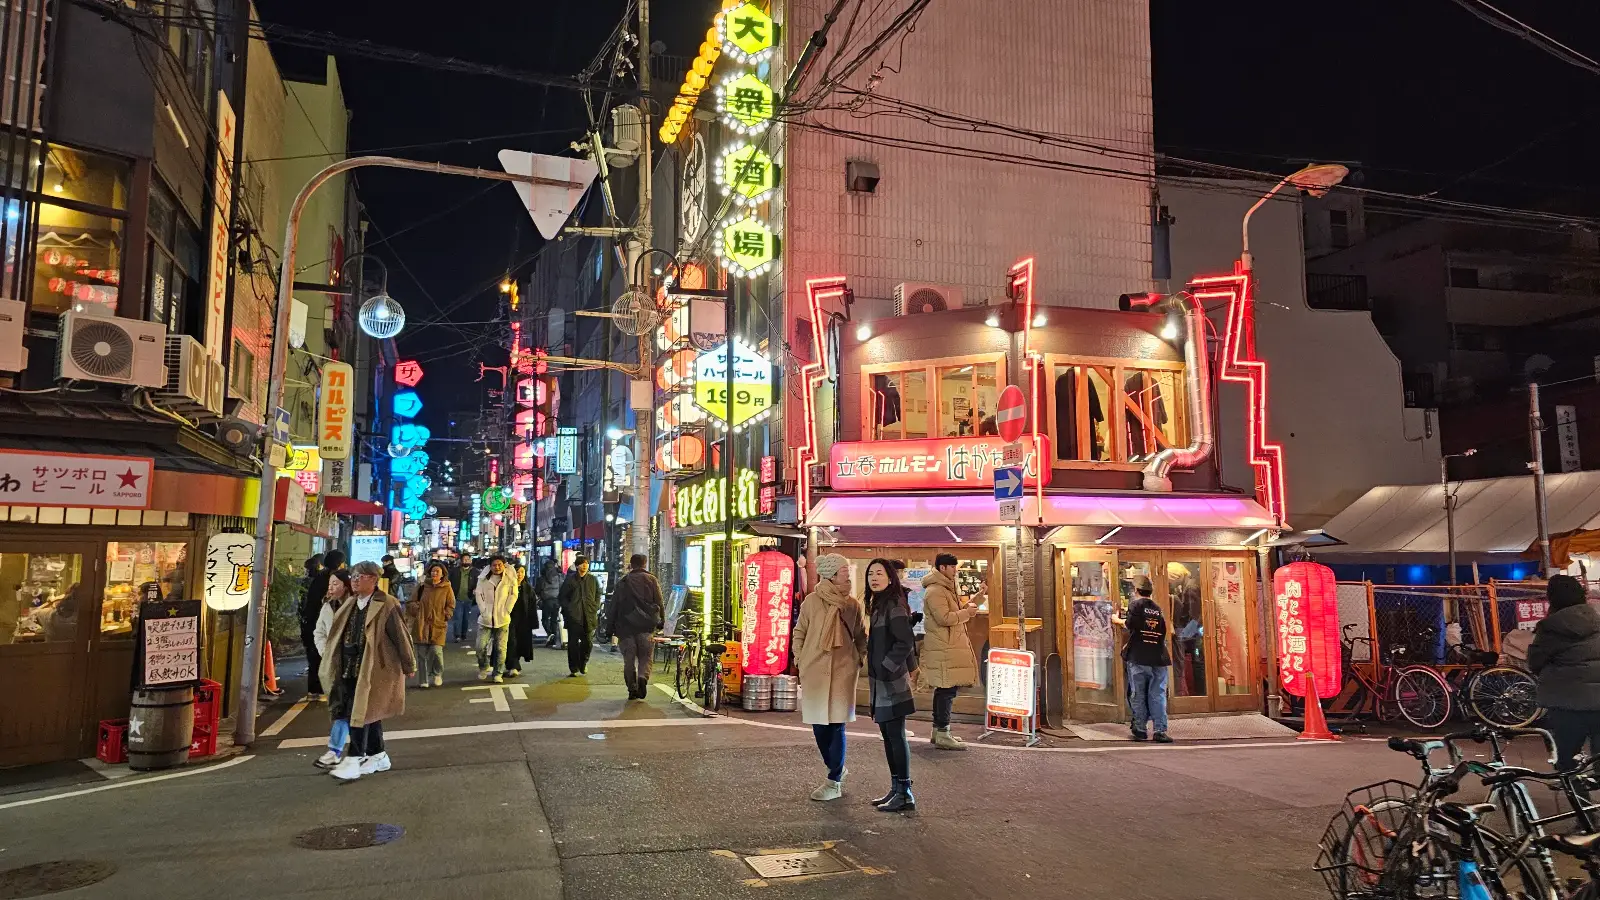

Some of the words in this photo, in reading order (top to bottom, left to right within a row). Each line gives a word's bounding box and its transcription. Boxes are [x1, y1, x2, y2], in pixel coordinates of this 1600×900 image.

[703, 368, 765, 380] ハイボール
[324, 371, 347, 440] カルピス
[32, 480, 105, 495] ビール
[838, 455, 875, 477] 立呑
[878, 455, 942, 474] ホルモン
[946, 444, 1037, 479] はがちん
[206, 545, 218, 596] シウマイ
[765, 580, 783, 664] 時々ラーメン
[777, 568, 792, 652] 肉とお酒と
[1285, 580, 1306, 671] 肉とお酒と
